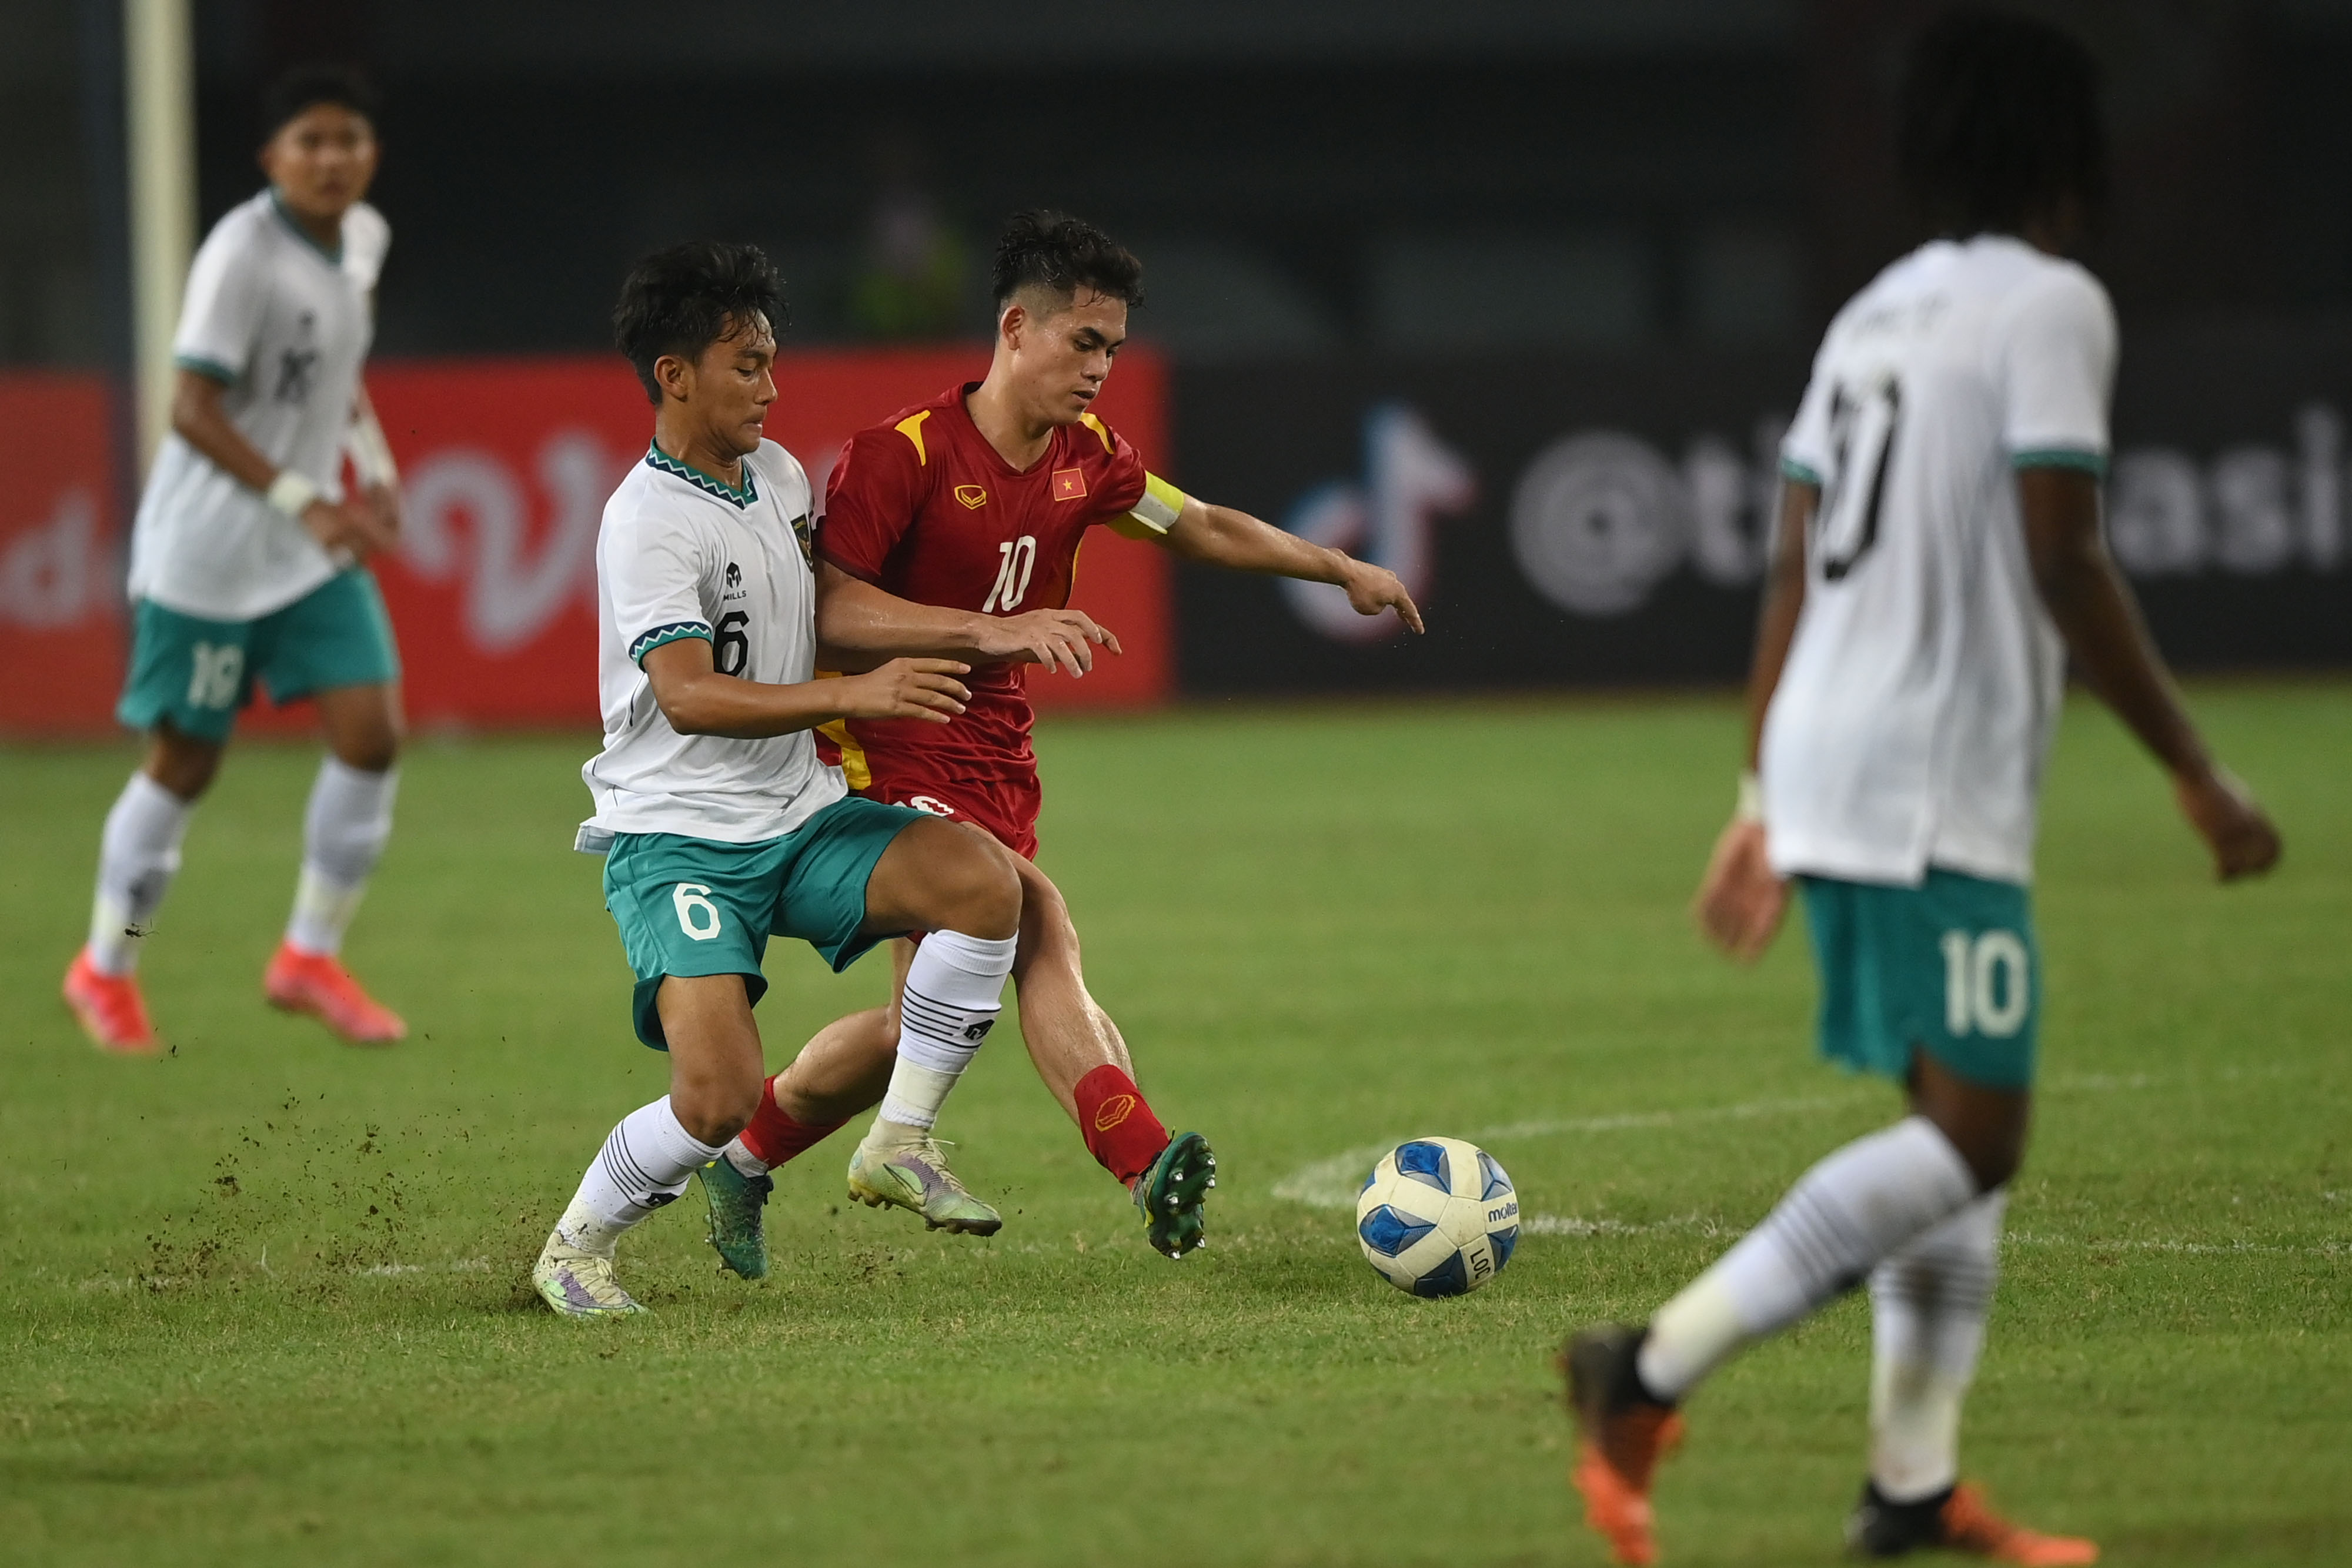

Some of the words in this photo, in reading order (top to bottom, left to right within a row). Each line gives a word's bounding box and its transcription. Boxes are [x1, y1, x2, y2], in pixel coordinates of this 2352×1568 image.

[723, 590, 746, 601] MILLS
[982, 536, 1036, 613] 10
[713, 610, 750, 677] 6
[672, 882, 721, 941] 6
[1940, 928, 2029, 1038] 10
[1488, 1202, 1518, 1222] molte
